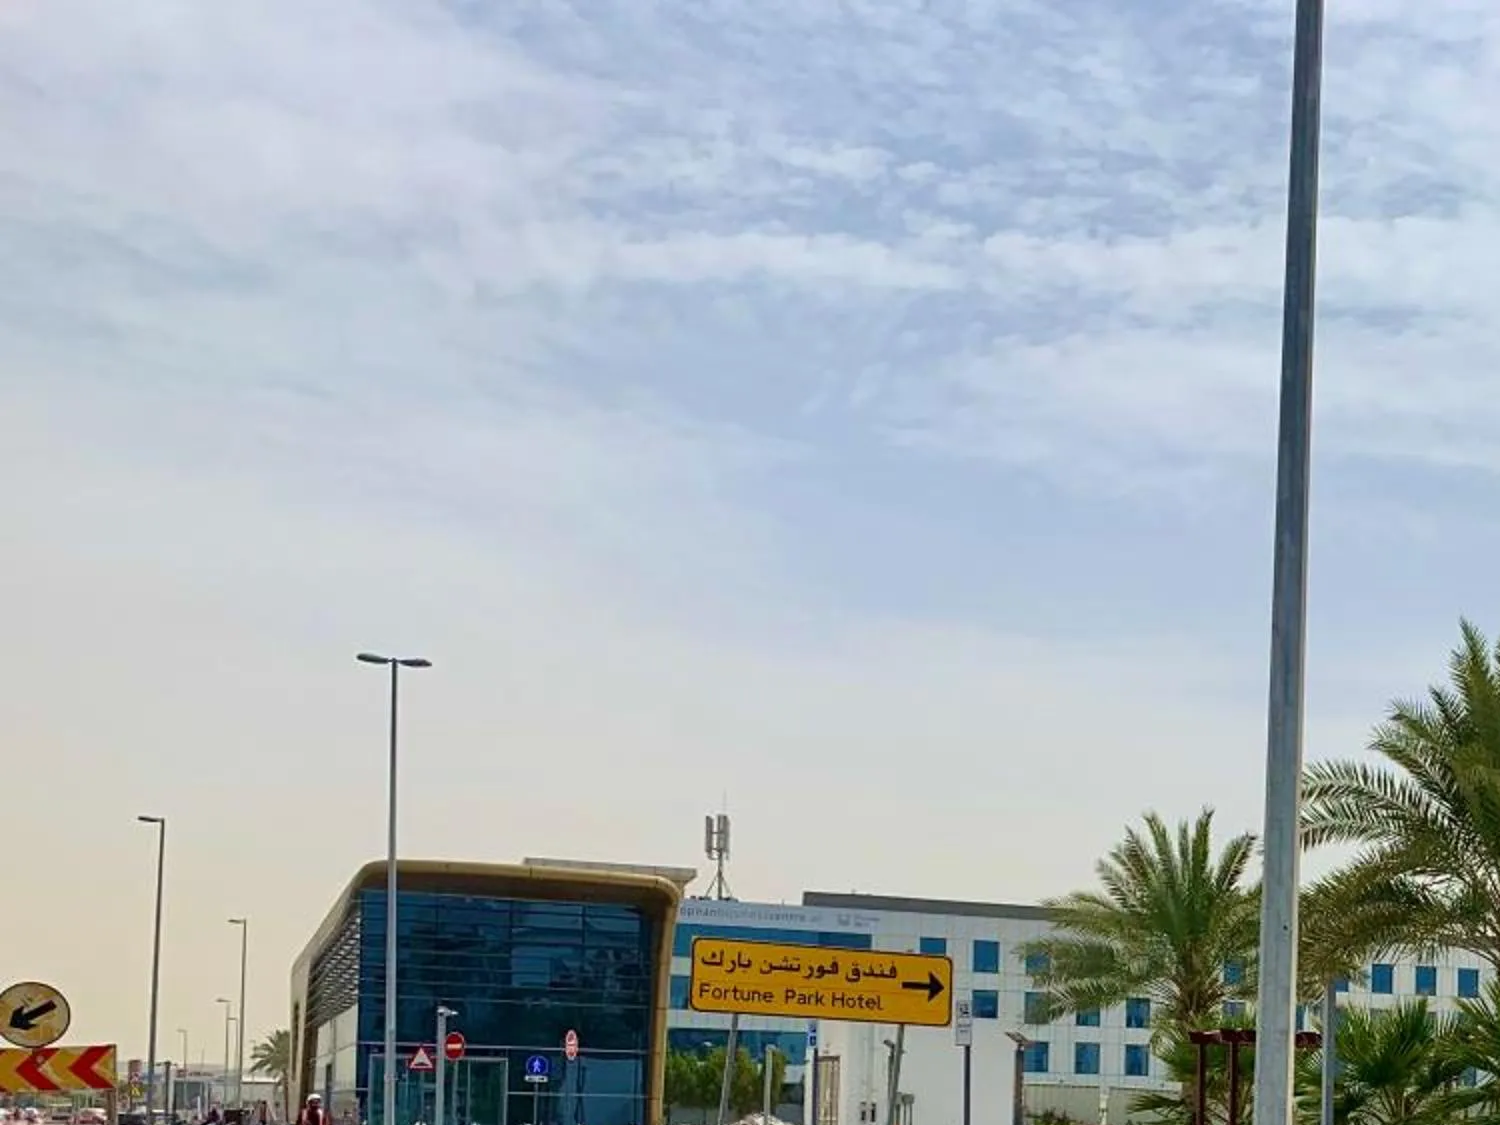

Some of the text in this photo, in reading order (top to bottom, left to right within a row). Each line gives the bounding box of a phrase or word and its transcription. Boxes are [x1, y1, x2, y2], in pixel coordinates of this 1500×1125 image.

[845, 962, 897, 983] فندق
[699, 983, 884, 1012] Fortune Park Hotel
